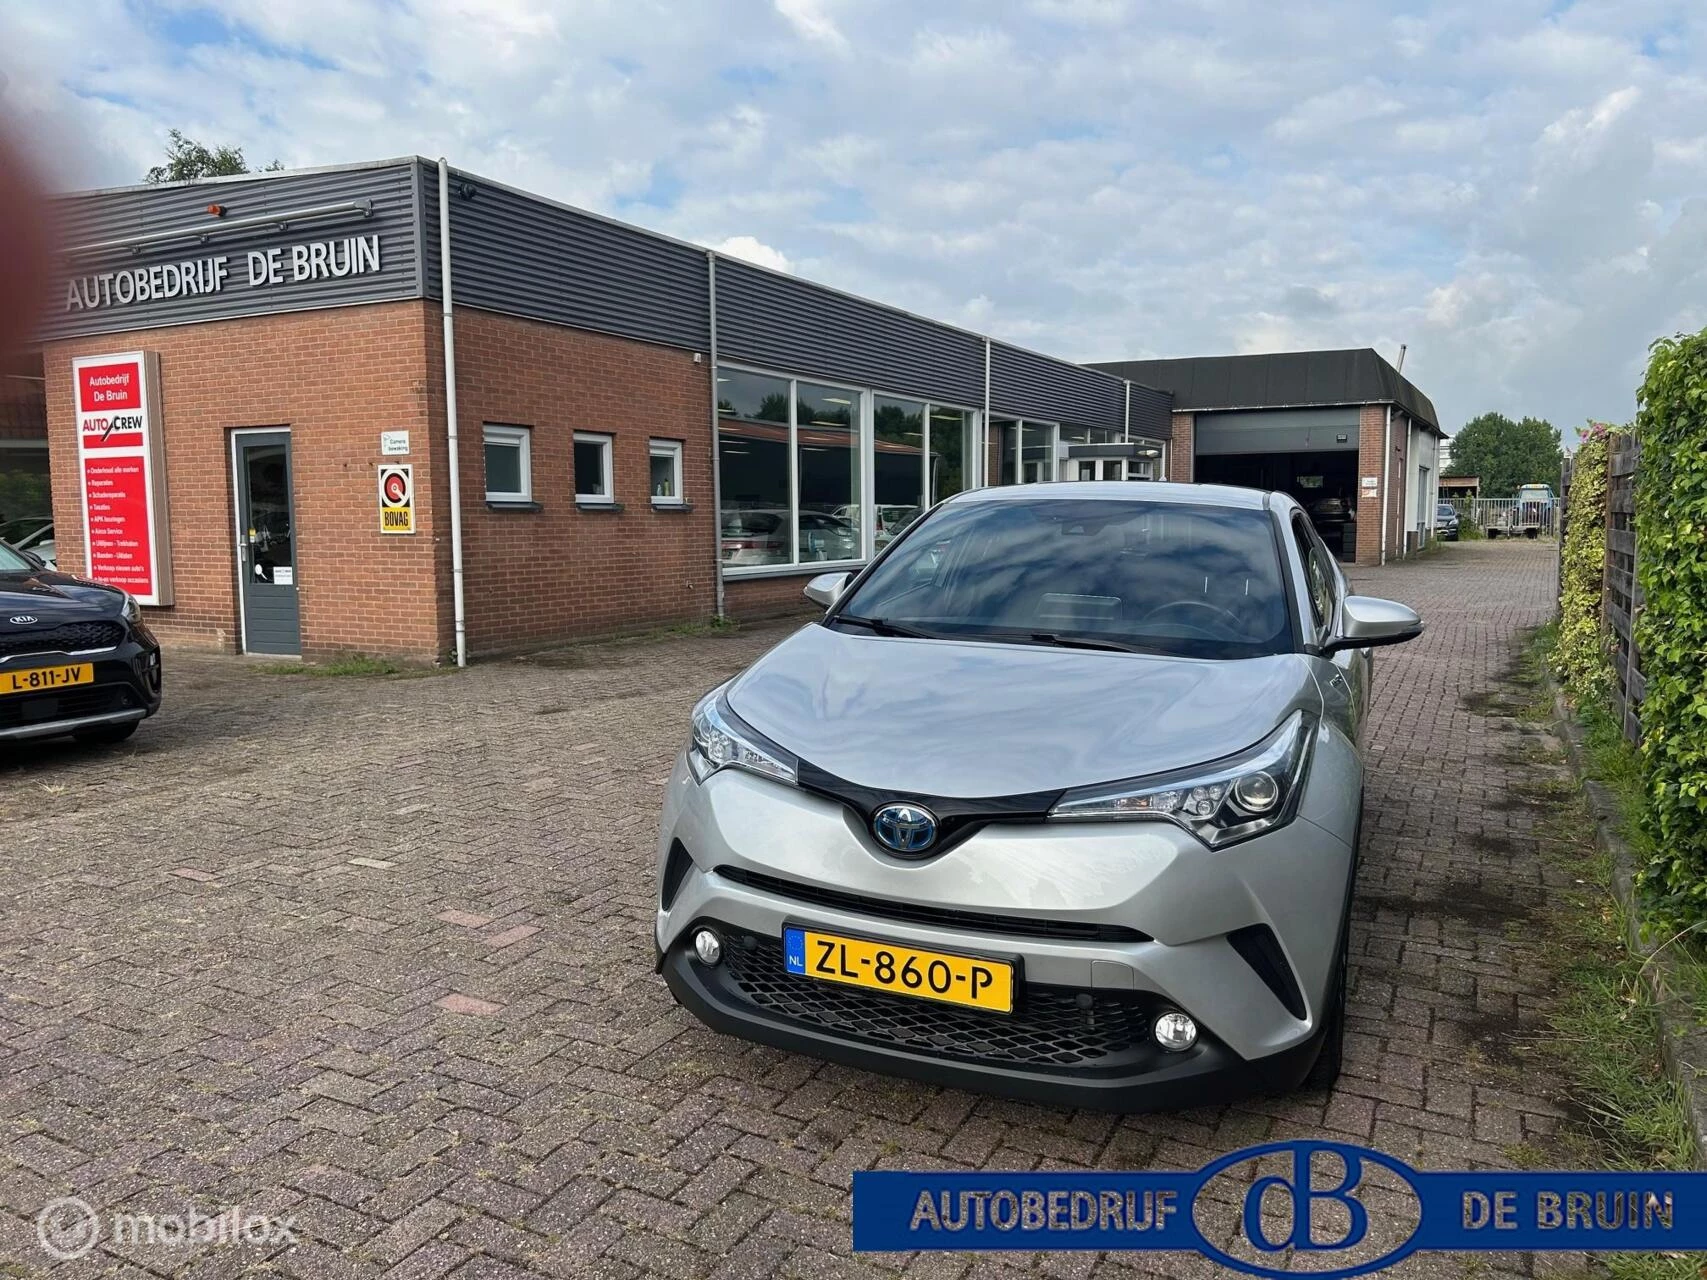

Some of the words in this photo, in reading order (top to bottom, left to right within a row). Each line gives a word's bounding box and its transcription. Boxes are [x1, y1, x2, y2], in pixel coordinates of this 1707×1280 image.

[65, 256, 229, 312] AUTOBEDRIJF
[248, 248, 286, 287] DE
[292, 234, 382, 282] BRUIN
[89, 373, 130, 386] Autobedrijf
[93, 391, 105, 402] De
[106, 390, 128, 401] Bruin
[384, 511, 409, 527] BOVAG
[12, 667, 81, 690] L-811-JV
[789, 955, 803, 967] NL
[815, 940, 993, 1000] ZL-860-P
